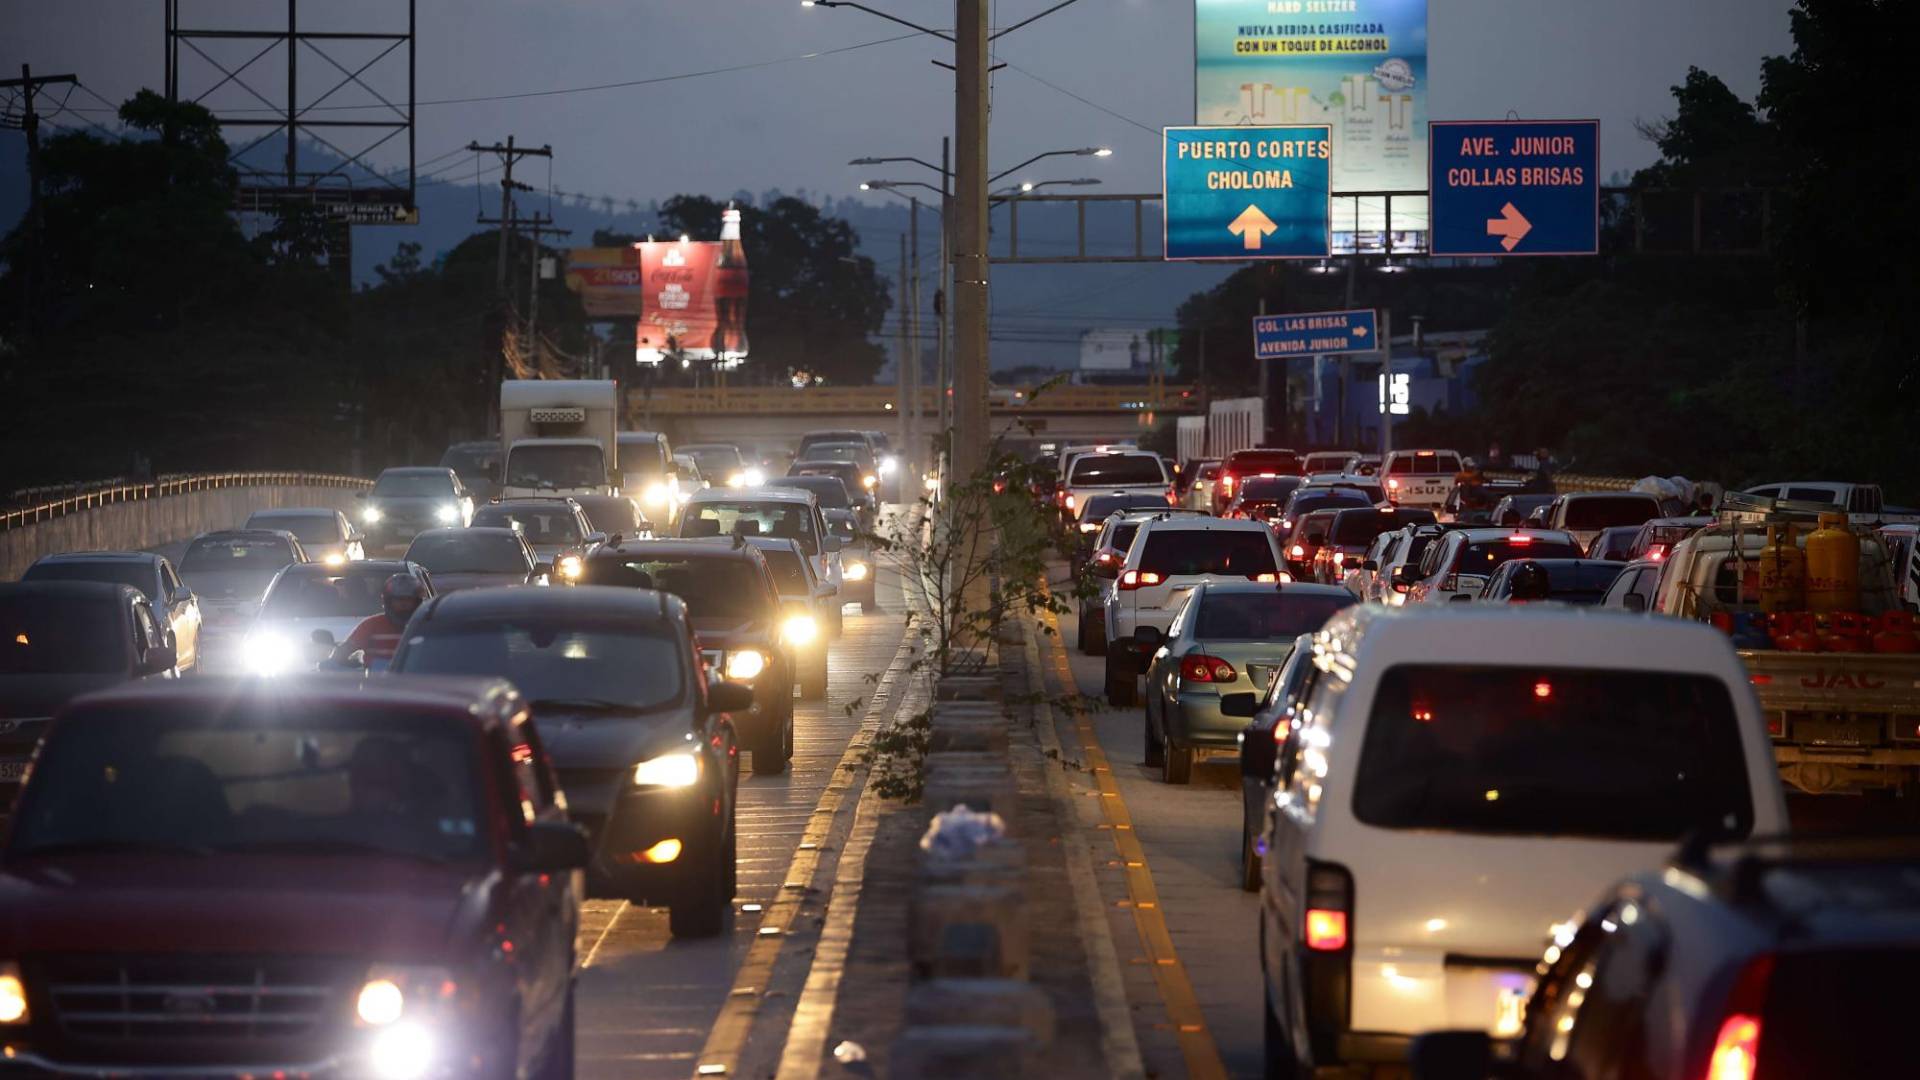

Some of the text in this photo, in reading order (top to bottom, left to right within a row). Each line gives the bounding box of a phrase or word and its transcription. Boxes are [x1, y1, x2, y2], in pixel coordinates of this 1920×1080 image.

[1238, 25, 1273, 36] NUEVA
[1277, 24, 1316, 35] BEBIDA
[1236, 39, 1387, 52] CON UN TOQUE DE ALCOHOL
[1178, 141, 1252, 159] PUERTO
[1257, 140, 1329, 158] CORTES
[1460, 137, 1575, 156] AVE. JUNIOR
[1207, 171, 1293, 190] CHOLOMA
[1521, 167, 1583, 186] BRISAS
[1258, 316, 1348, 332] COL. LAS BRISAS
[1260, 337, 1348, 353] AVENIDA JUNIOR
[1801, 668, 1886, 689] JAC
